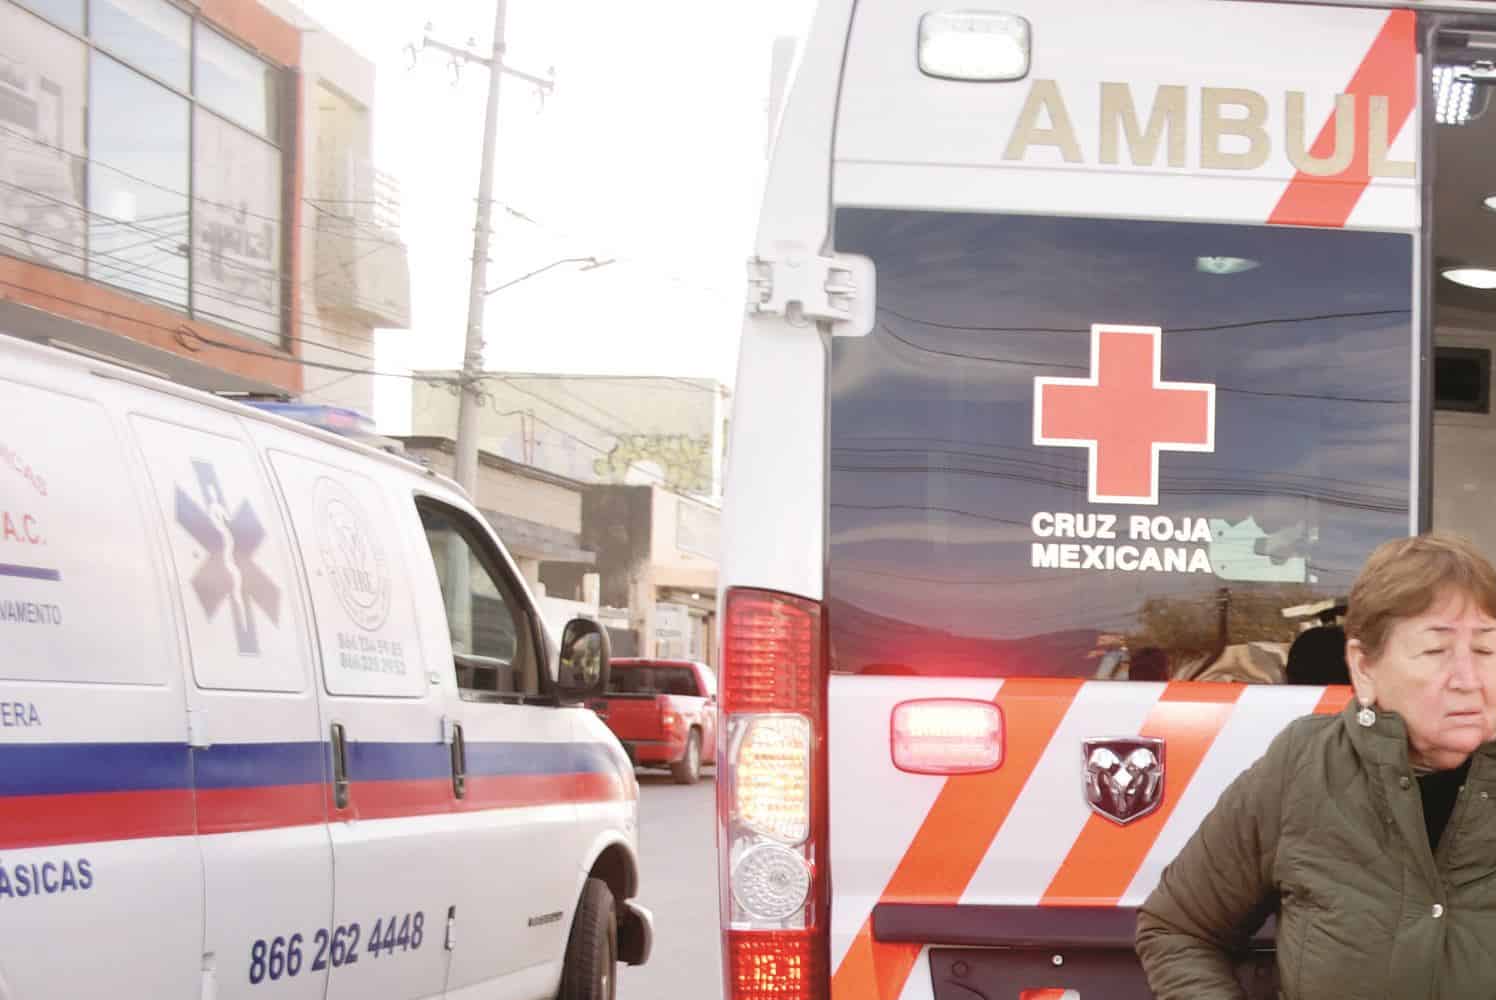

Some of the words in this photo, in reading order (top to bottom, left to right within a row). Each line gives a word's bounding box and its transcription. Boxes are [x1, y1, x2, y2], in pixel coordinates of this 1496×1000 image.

[1002, 78, 1416, 178] AMBUL
[1031, 511, 1117, 539] CRUZ
[1129, 515, 1213, 543] ROJA
[1031, 543, 1213, 574] MEXICANA
[249, 932, 304, 985] 866
[310, 922, 361, 972] 262
[366, 910, 425, 959] 4448
